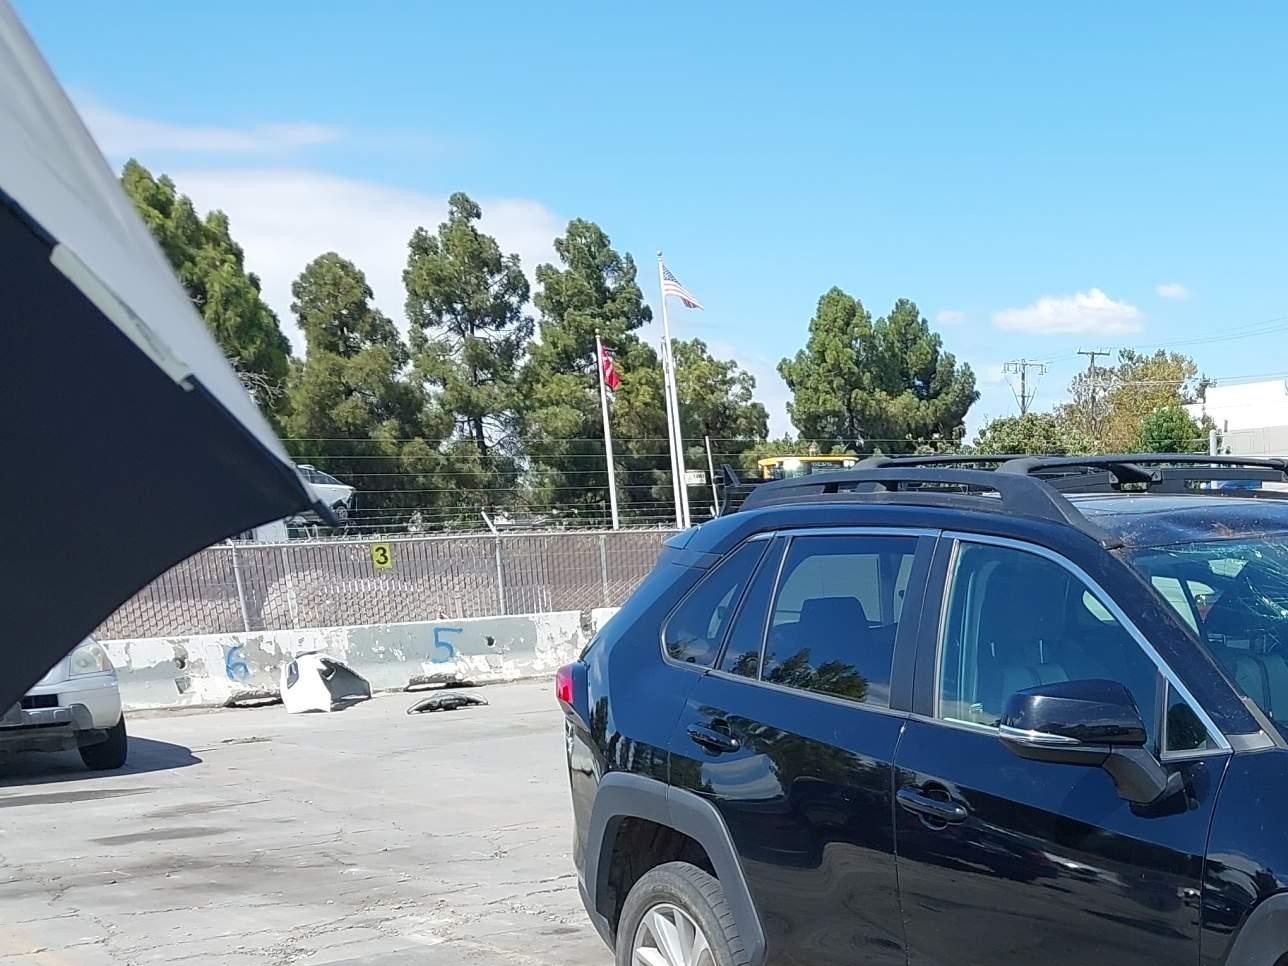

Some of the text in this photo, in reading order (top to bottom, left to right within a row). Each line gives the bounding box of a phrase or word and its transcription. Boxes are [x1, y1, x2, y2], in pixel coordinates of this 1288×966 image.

[375, 546, 389, 565] 3
[226, 645, 249, 681] 6
[433, 627, 463, 664] 5
